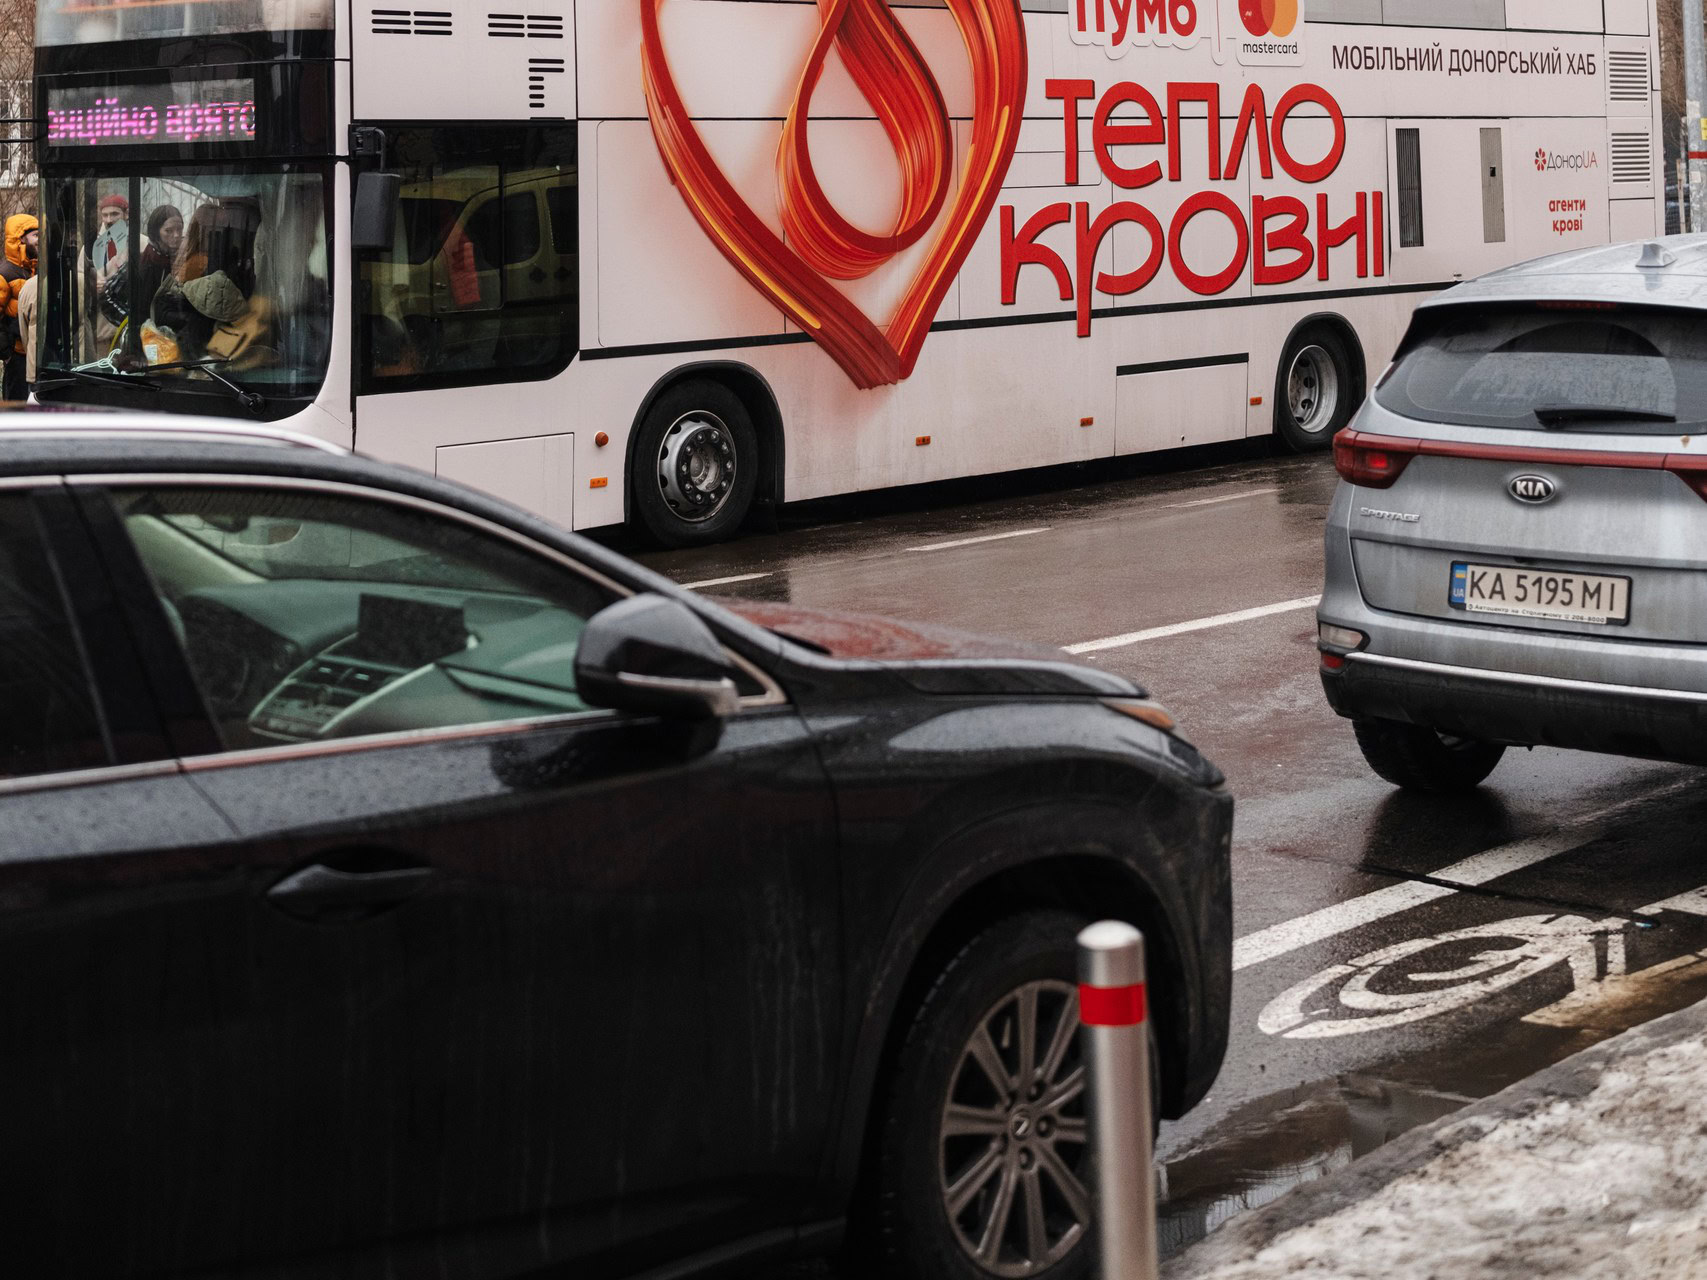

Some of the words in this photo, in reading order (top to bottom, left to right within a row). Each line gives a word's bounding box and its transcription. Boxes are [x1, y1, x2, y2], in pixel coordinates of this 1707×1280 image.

[1243, 42, 1298, 55] mastercard
[1332, 42, 1443, 71] МОБІЛЬНИЙ
[1448, 47, 1562, 76] ДОНОРСЬКИЙ
[1566, 53, 1597, 76] ХАБ
[1547, 150, 1598, 172] ДонорUA
[1548, 199, 1586, 212] агенти
[1552, 213, 1583, 236] крові
[1516, 480, 1547, 497] KIA
[1360, 507, 1420, 522] SPORTAGE
[1453, 588, 1465, 598] UA
[1469, 570, 1506, 601] KA
[1514, 574, 1573, 607] 5195
[1581, 580, 1615, 611] MI
